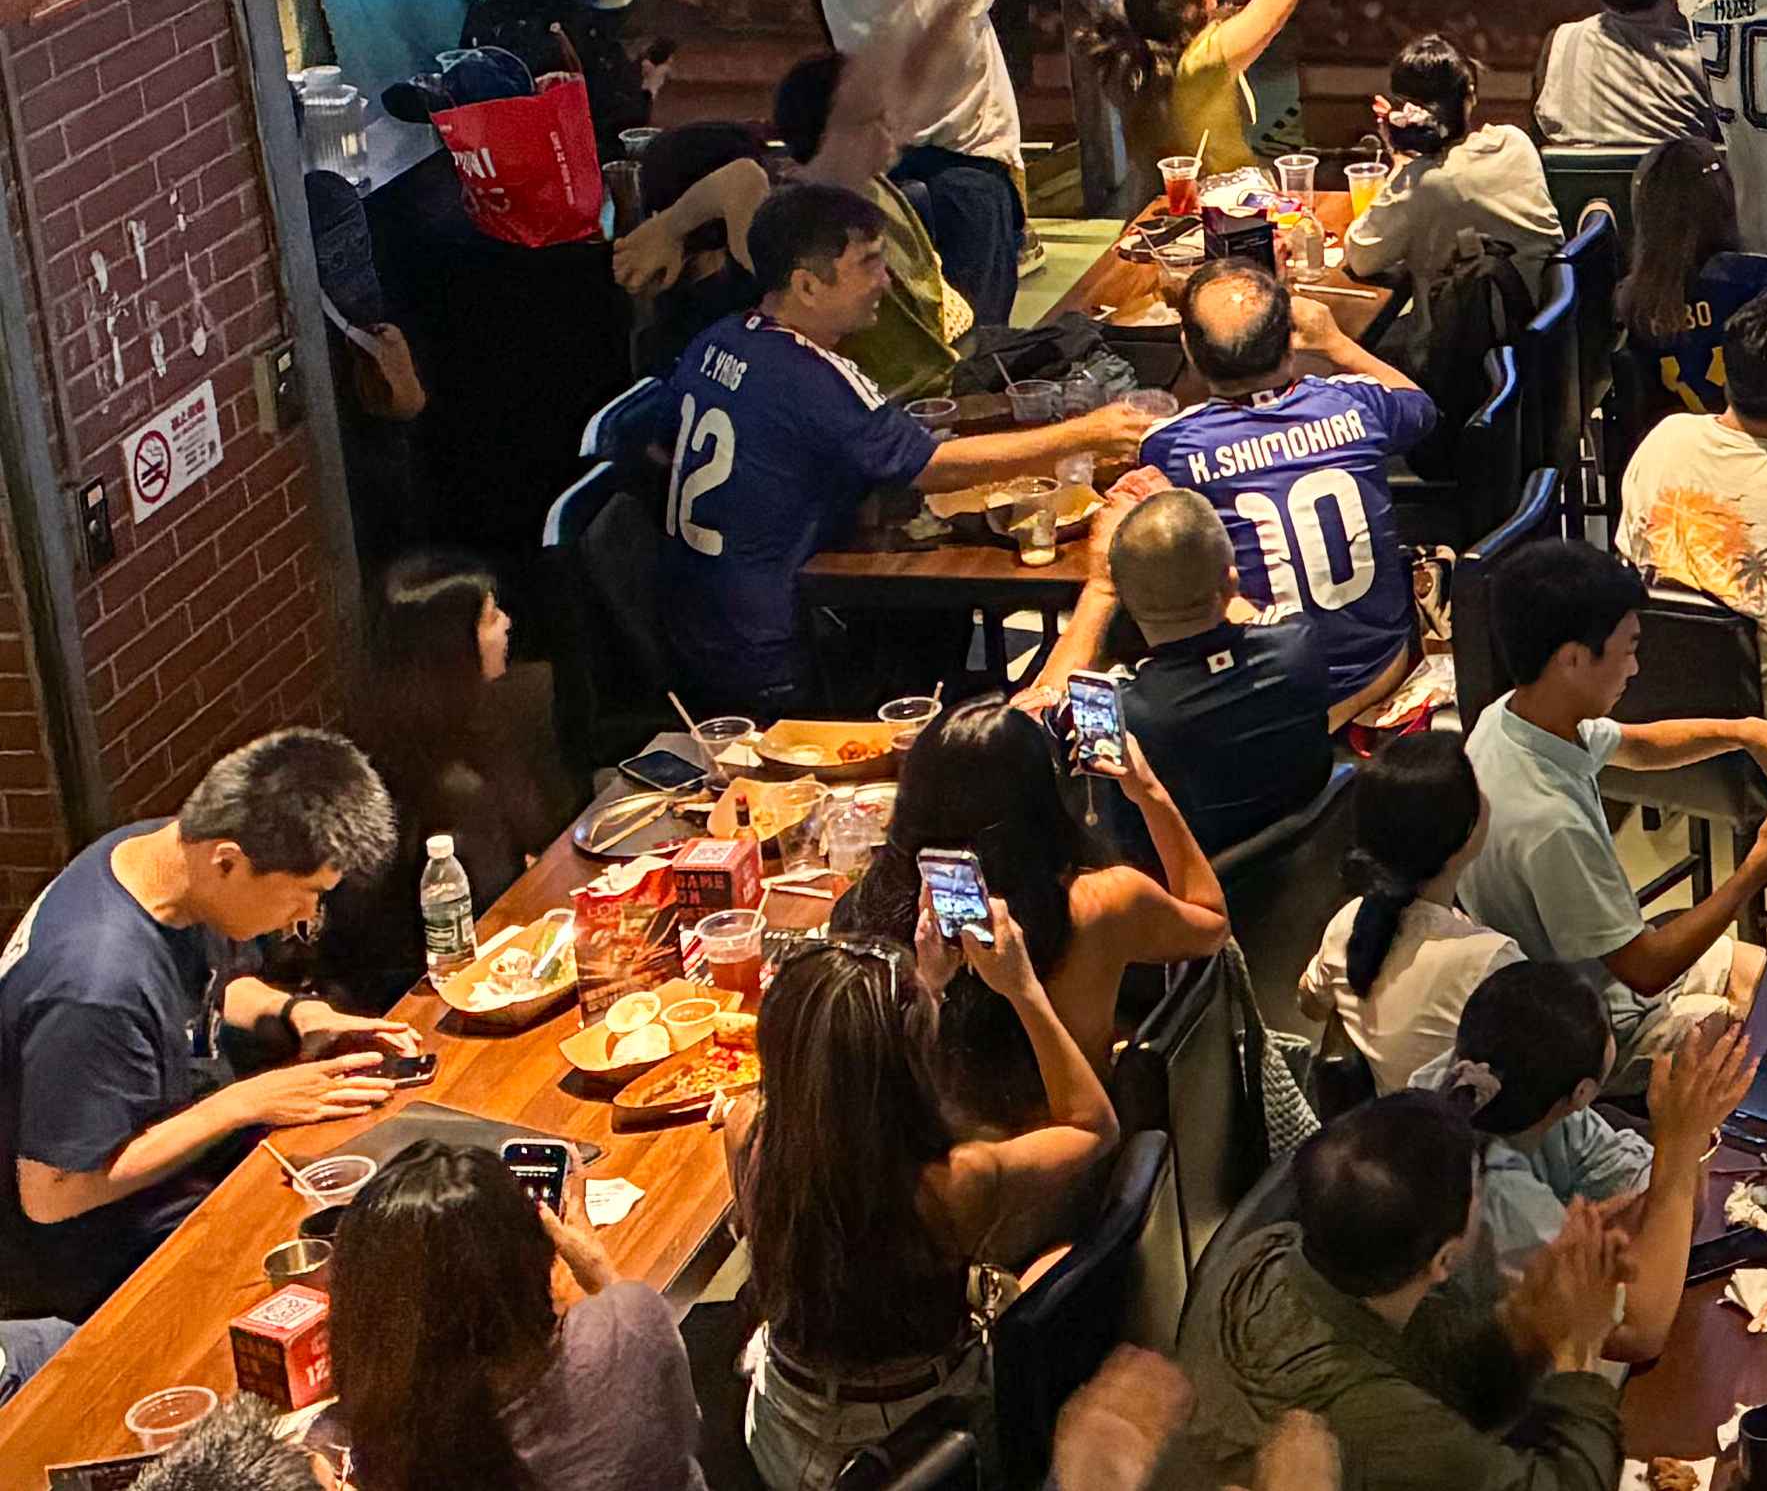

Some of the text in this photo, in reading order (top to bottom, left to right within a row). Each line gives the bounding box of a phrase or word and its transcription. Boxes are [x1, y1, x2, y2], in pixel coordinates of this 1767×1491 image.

[666, 392, 736, 557] 12
[1187, 408, 1367, 485] K.SHIMOHIRA
[1234, 468, 1376, 625] 10
